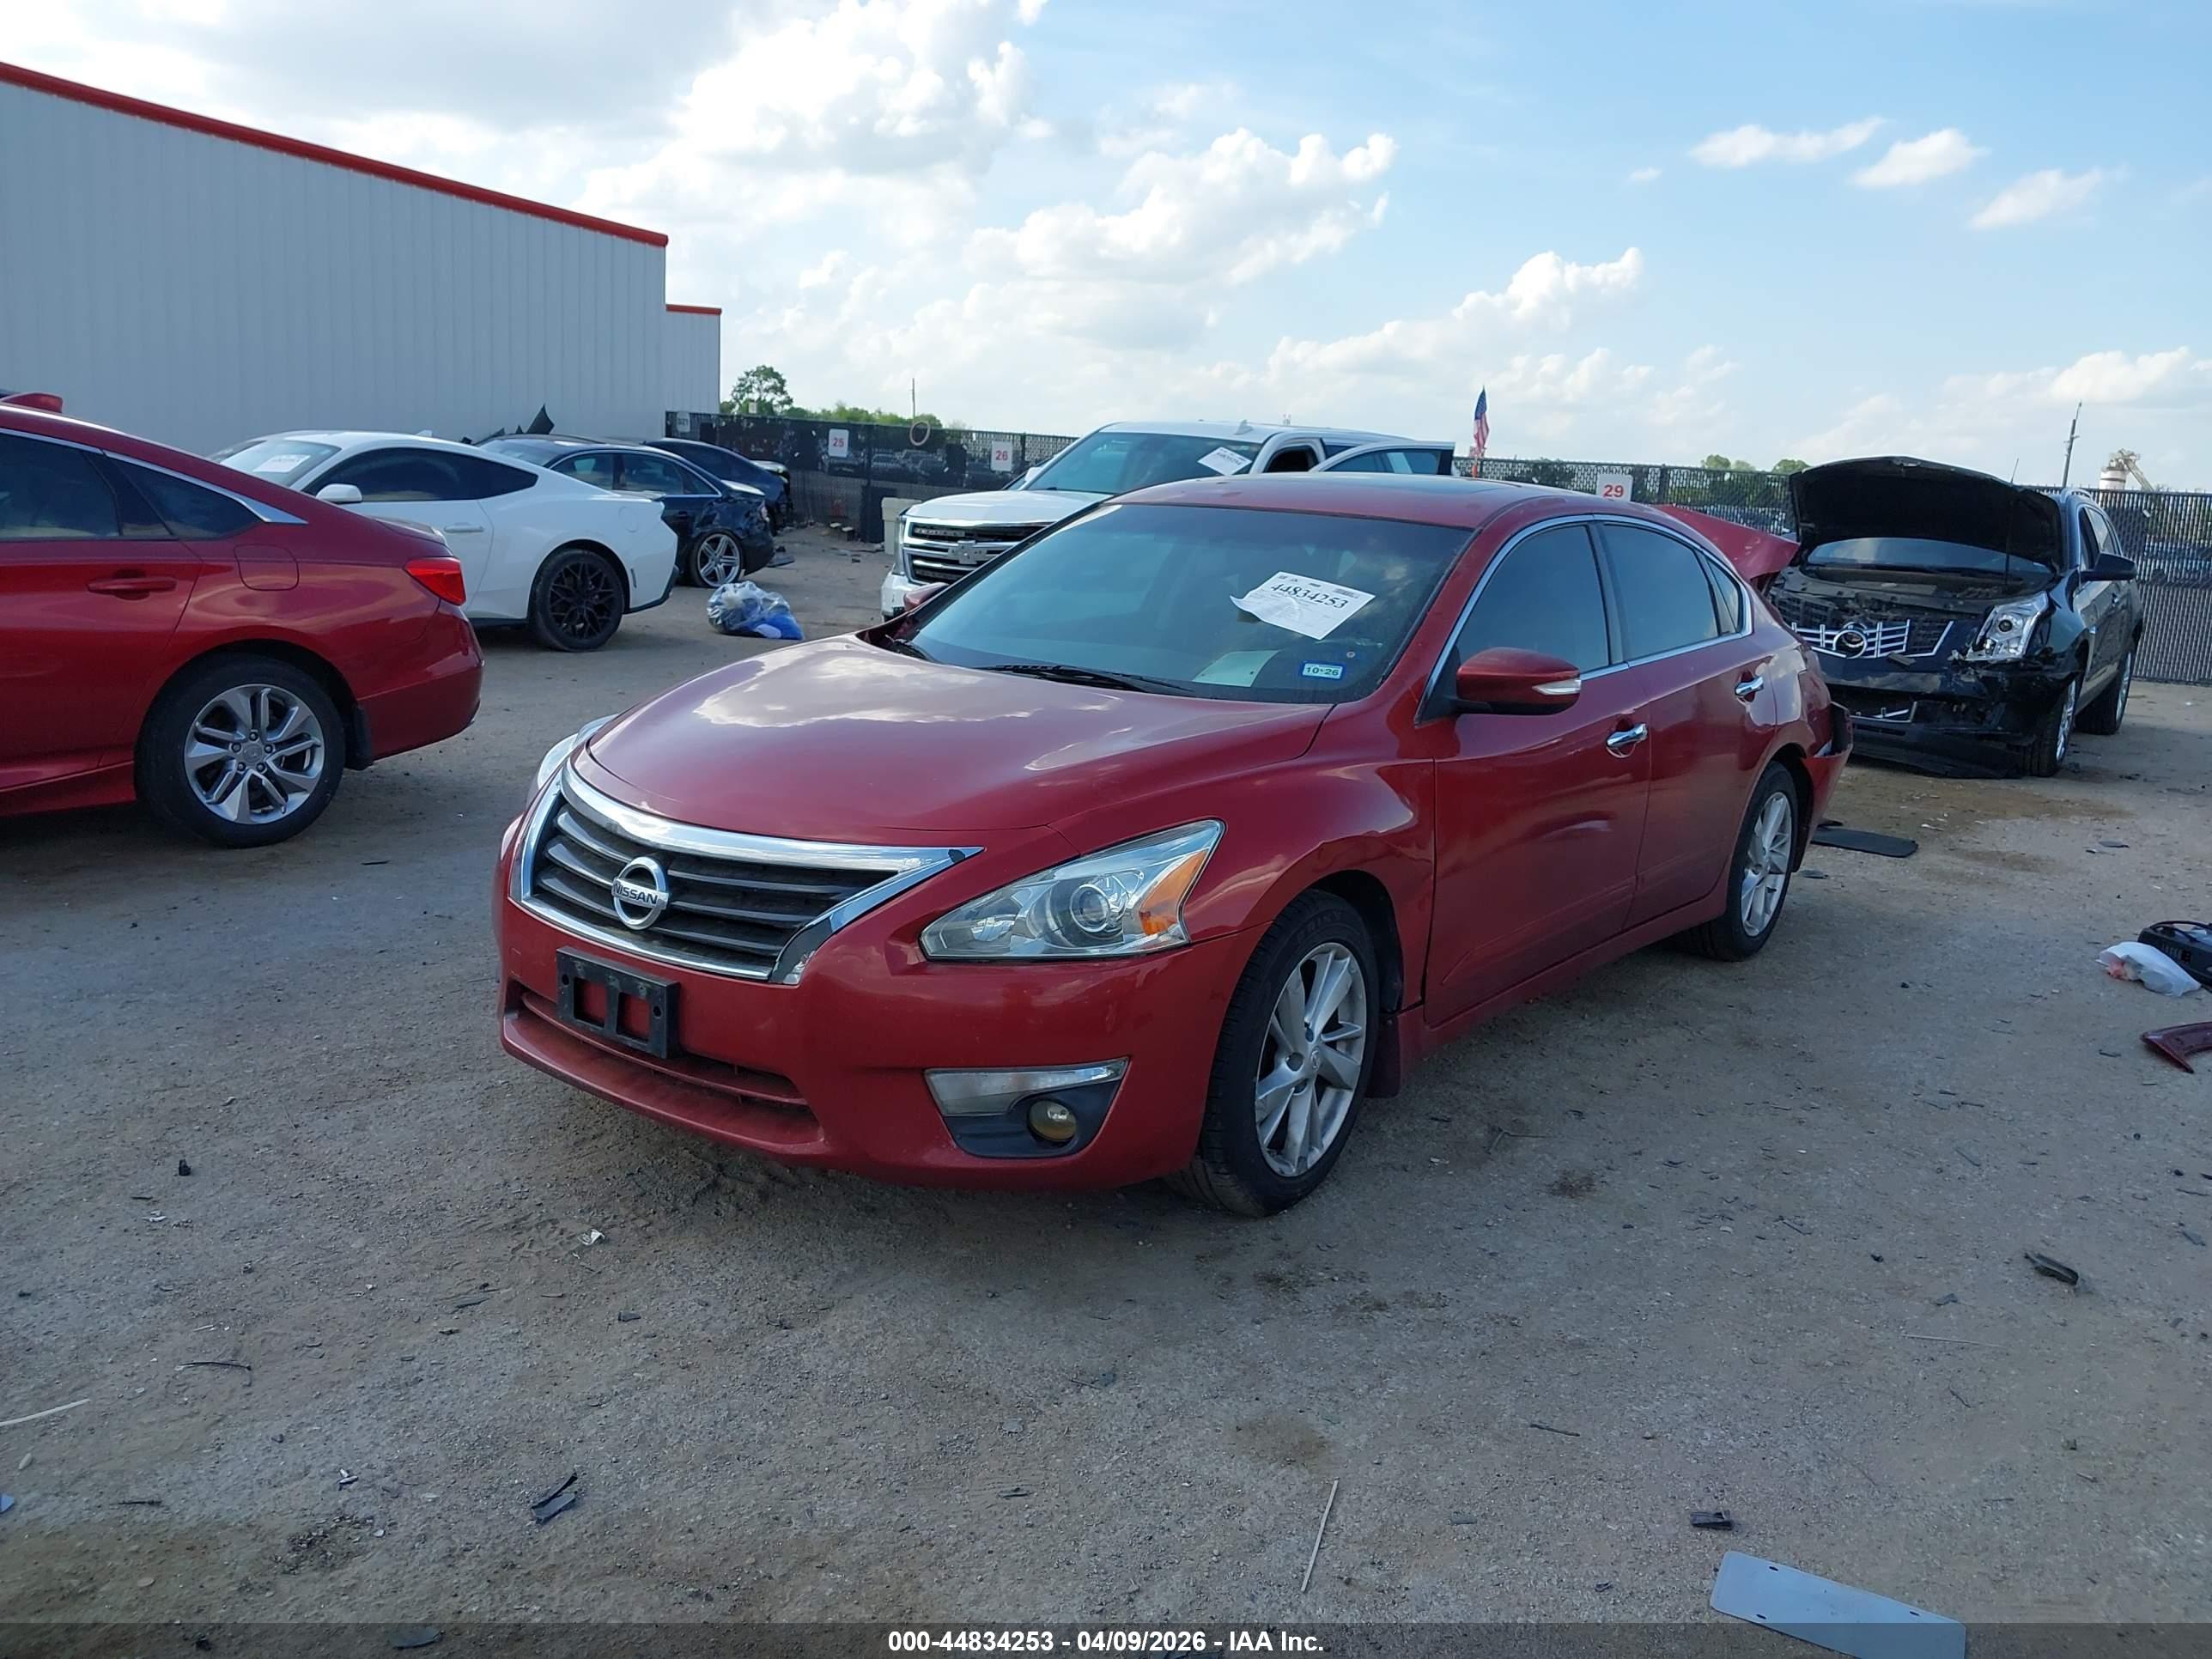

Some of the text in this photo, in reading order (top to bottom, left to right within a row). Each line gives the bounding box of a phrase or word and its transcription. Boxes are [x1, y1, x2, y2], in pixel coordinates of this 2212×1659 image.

[832, 437, 845, 447] 25
[995, 449, 1008, 460] 26
[1603, 484, 1624, 498] 29
[1270, 584, 1349, 610] 44834253
[613, 881, 658, 904] NISSAN
